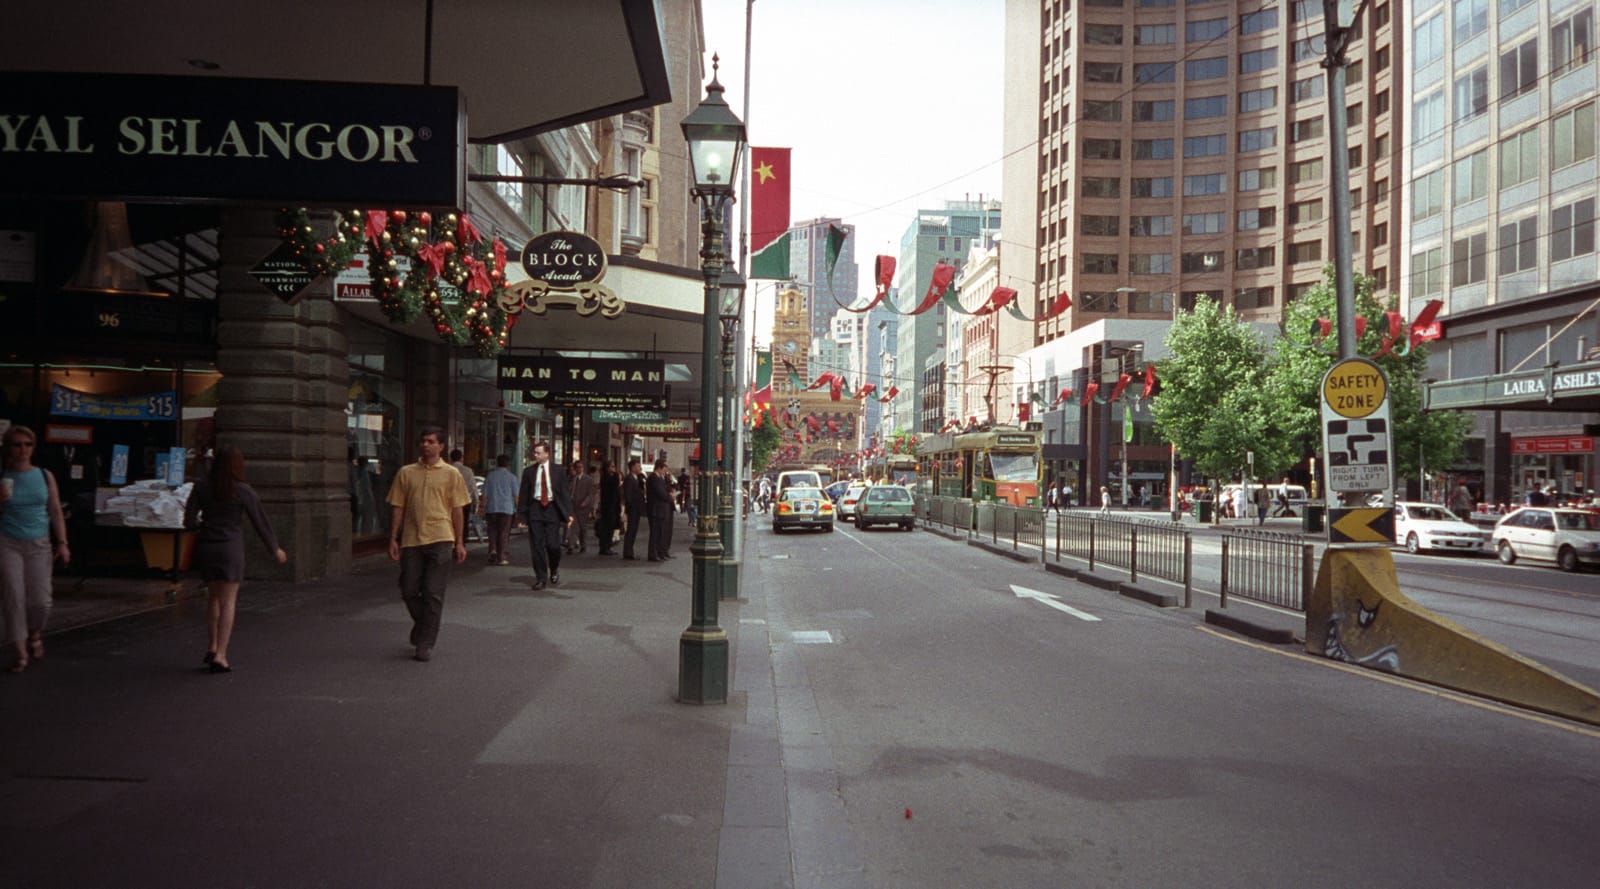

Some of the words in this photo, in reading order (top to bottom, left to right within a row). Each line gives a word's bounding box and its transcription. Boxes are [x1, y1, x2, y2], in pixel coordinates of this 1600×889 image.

[550, 239, 575, 250] The
[529, 253, 598, 266] BLOCK
[541, 270, 585, 281] Arcade
[99, 313, 120, 327] 96
[502, 367, 551, 379] MAN
[569, 369, 597, 380] TO
[611, 370, 660, 382] MAN
[1329, 375, 1379, 389] SAFETY
[1504, 379, 1545, 395] LAURA
[1338, 395, 1374, 409] ZONE
[1363, 465, 1385, 473] TURN
[1333, 473, 1356, 481] FROM
[1361, 472, 1380, 480] LEFT
[1349, 480, 1369, 488] ONLY
